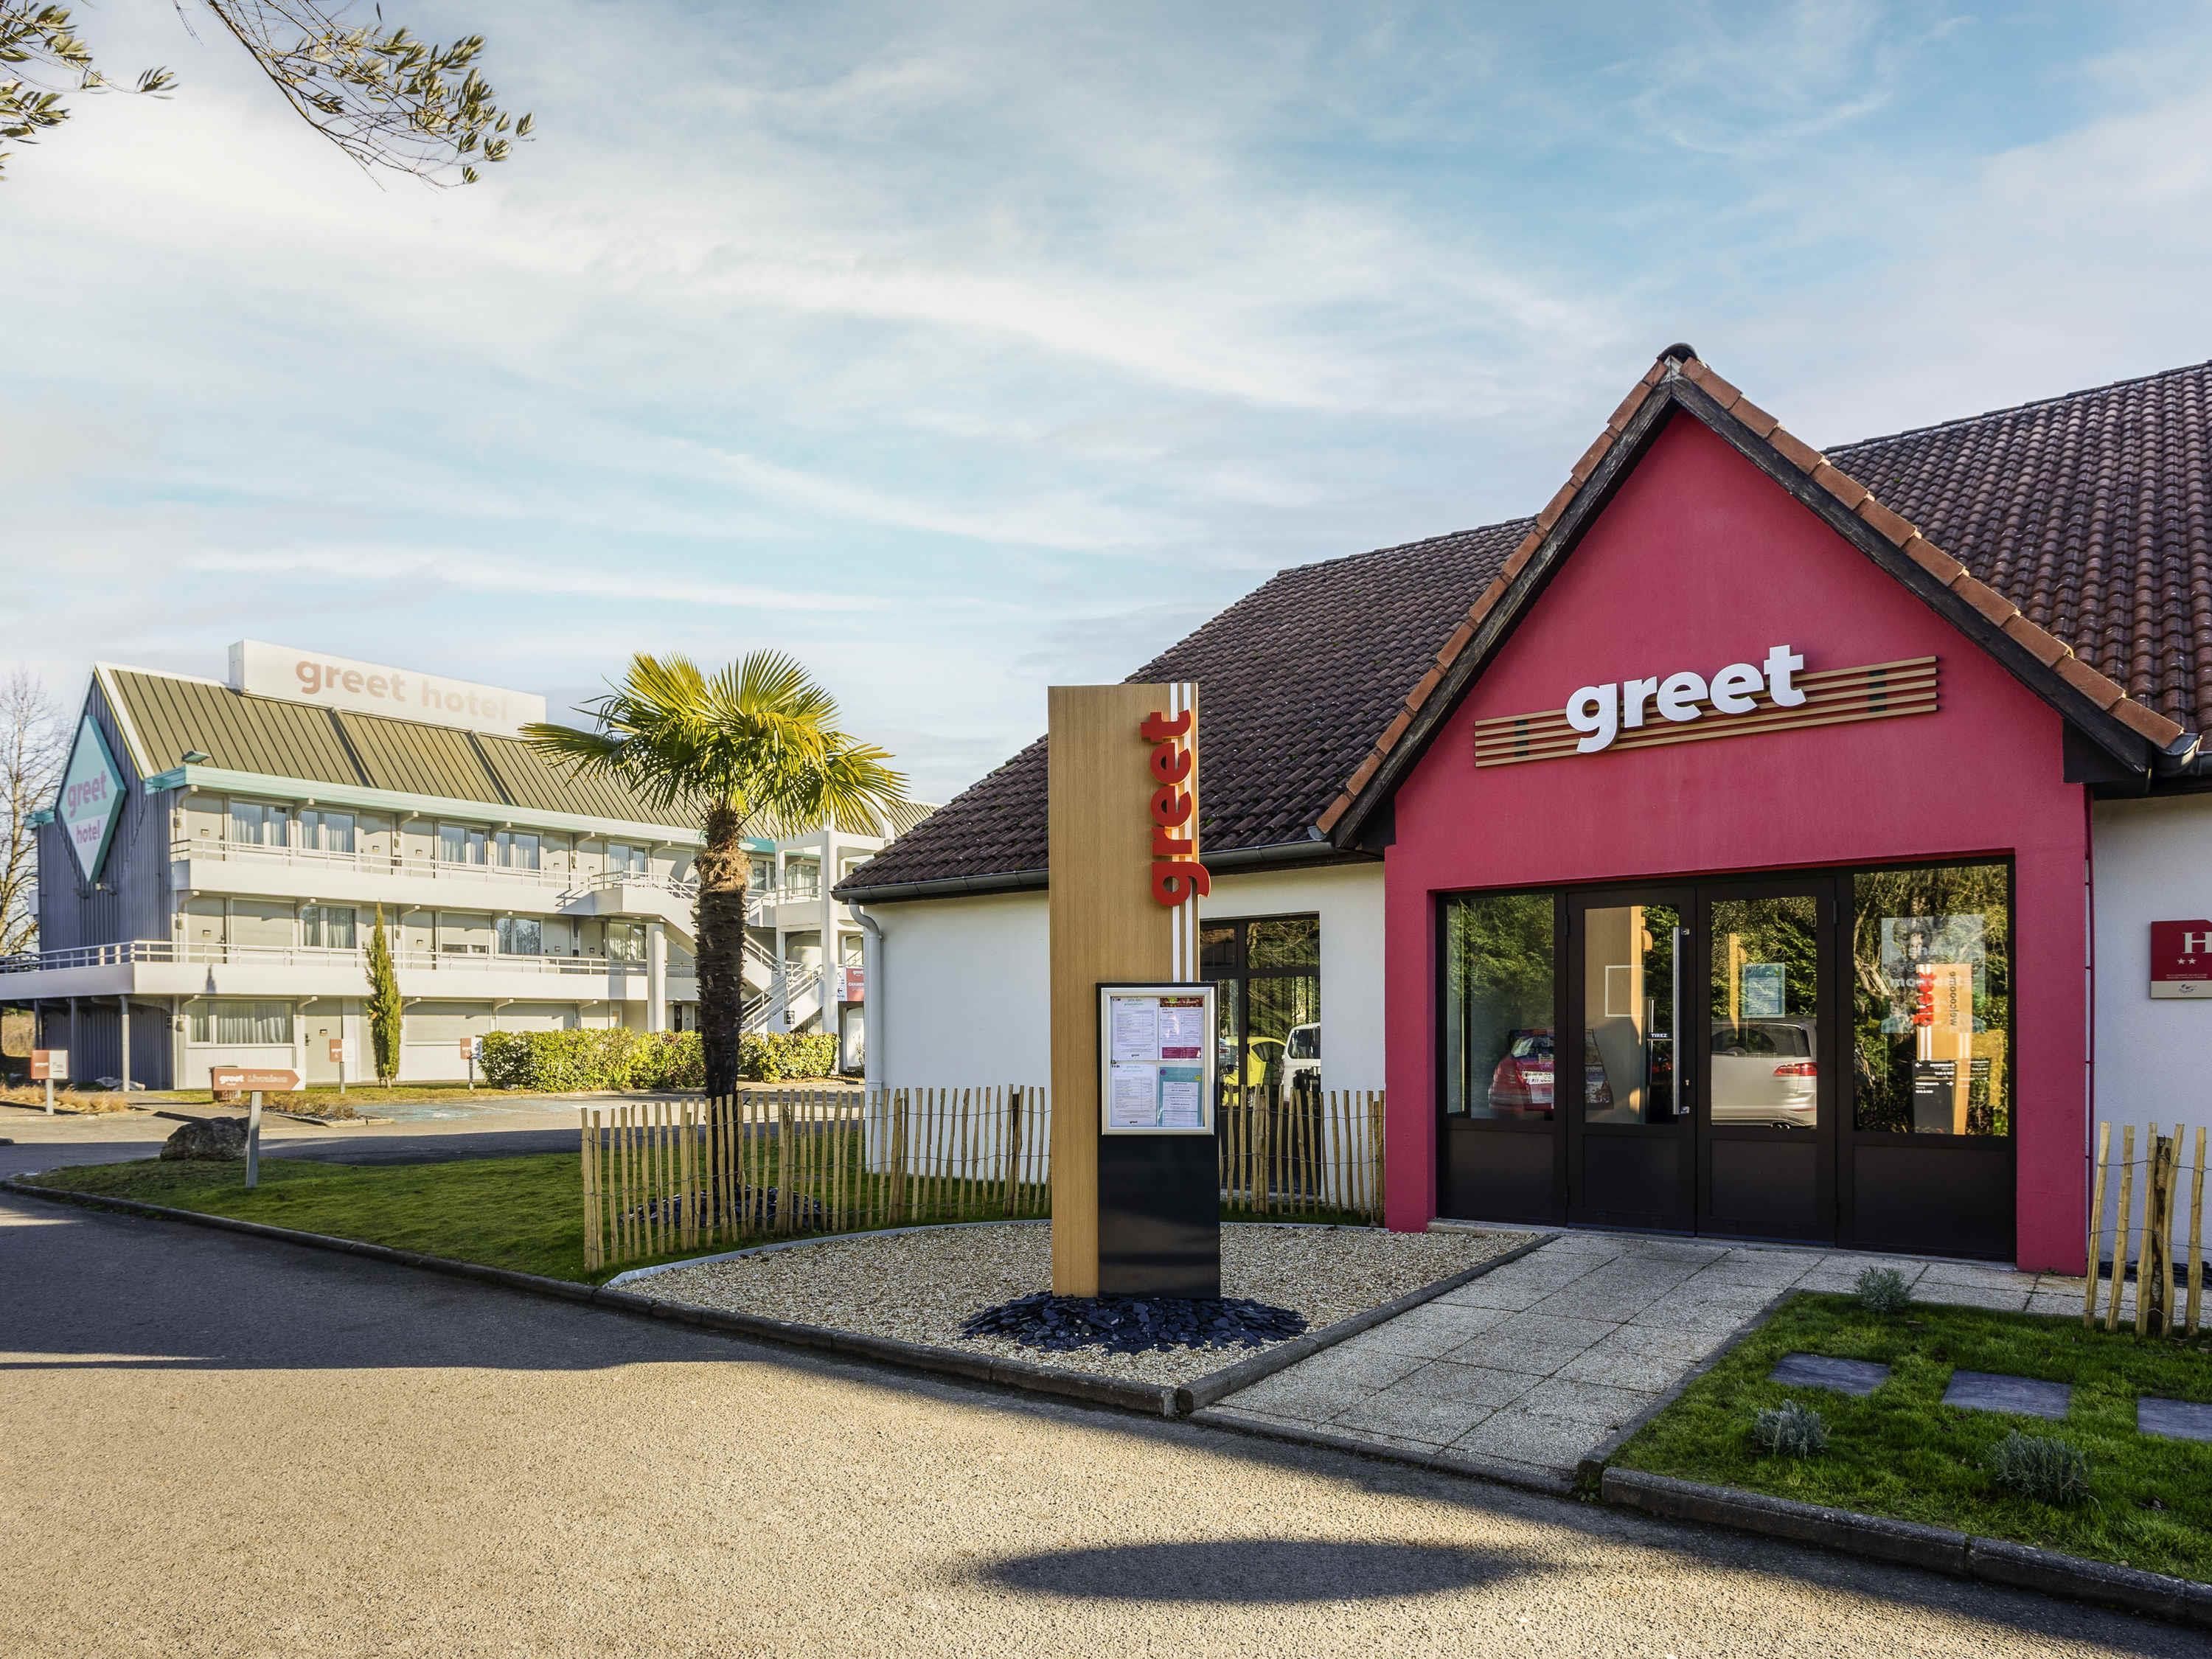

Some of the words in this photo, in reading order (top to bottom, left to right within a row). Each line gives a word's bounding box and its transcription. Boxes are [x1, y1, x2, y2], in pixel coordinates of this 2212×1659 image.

[295, 661, 406, 703] greet
[421, 679, 508, 720] hotel
[1565, 644, 1807, 753] greet
[68, 771, 107, 817] greet
[1140, 709, 1211, 907] greet
[77, 820, 100, 844] hotel
[2183, 932, 2212, 953] H
